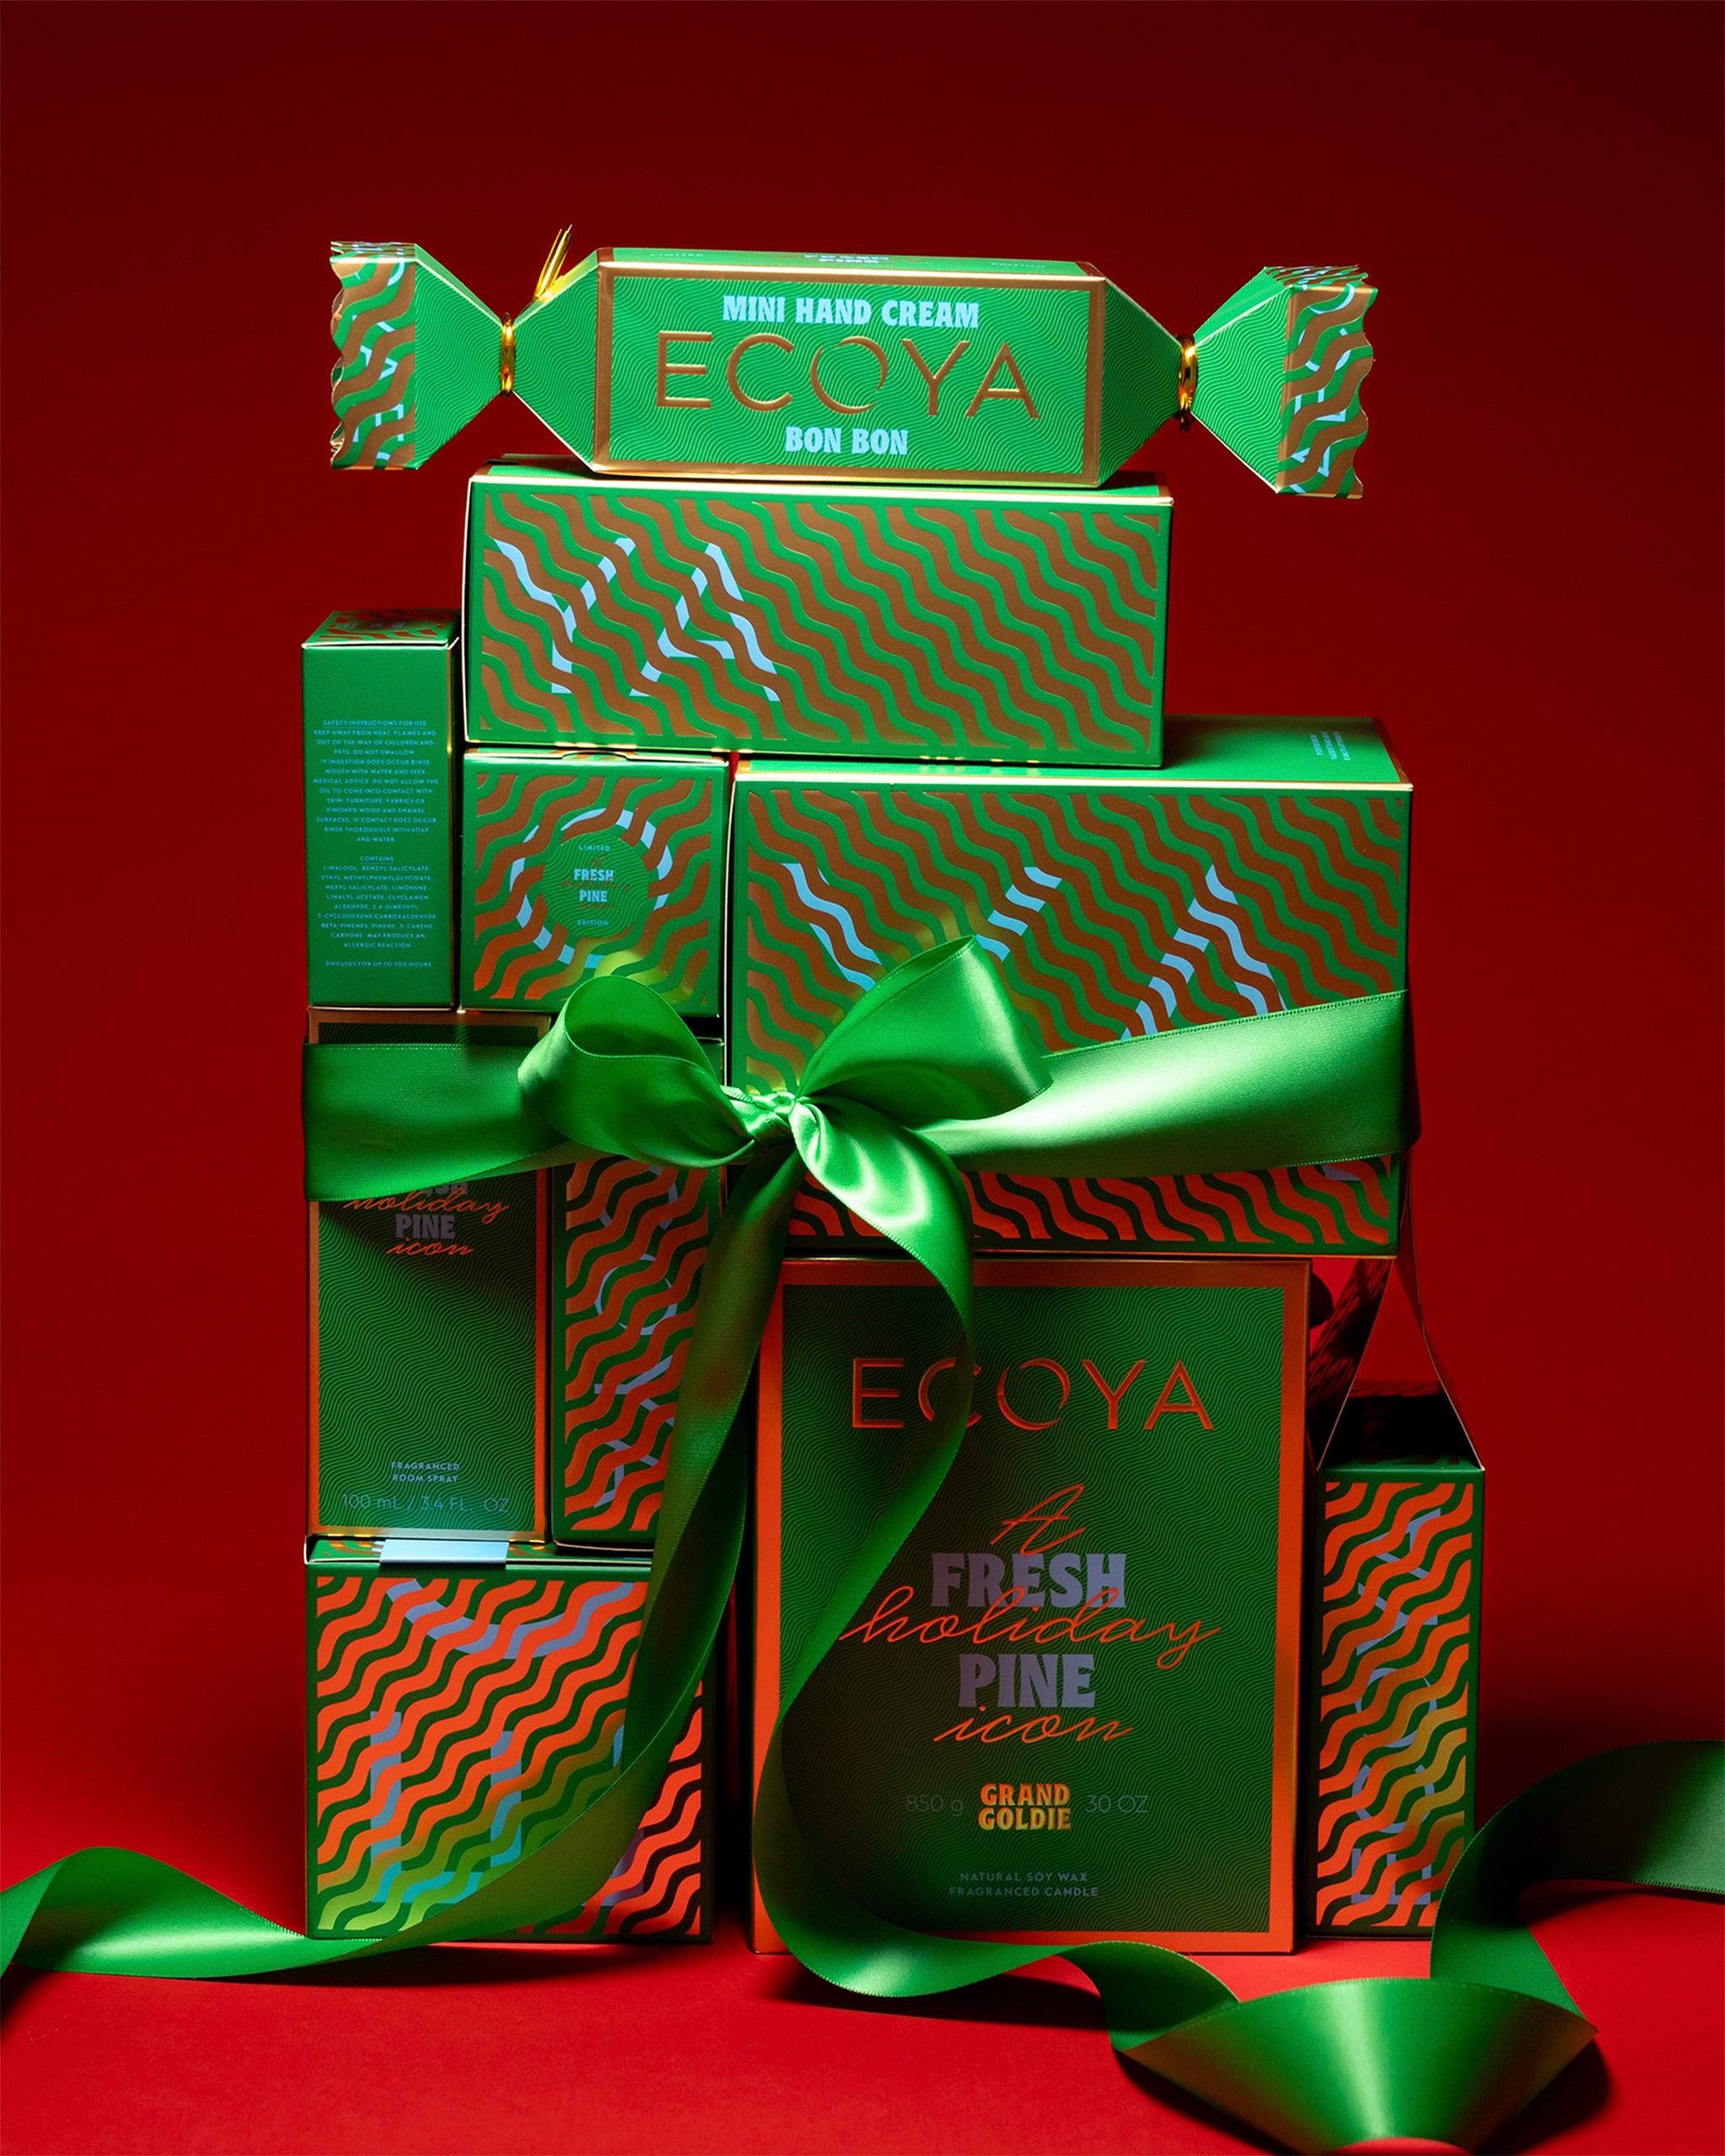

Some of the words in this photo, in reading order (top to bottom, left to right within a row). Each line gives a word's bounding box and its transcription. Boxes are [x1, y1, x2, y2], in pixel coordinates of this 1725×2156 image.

[722, 295, 786, 323] MINI
[795, 297, 871, 326] HAND
[881, 301, 980, 328] CREAM
[655, 331, 1039, 419] ECOYA
[784, 426, 841, 453] BON
[852, 429, 908, 456] BON
[574, 868, 614, 881] FRESH
[579, 889, 607, 902] PINE
[396, 1214, 456, 1240] PINE
[386, 1238, 474, 1257] icon
[852, 1357, 1214, 1431] ECOYA
[391, 1461, 460, 1470] FRAGRANCED
[393, 1474, 424, 1482] ROOM
[342, 1494, 371, 1509] 100
[420, 1497, 444, 1511] 3.4
[483, 1497, 510, 1513] OZ
[989, 1483, 1086, 1556] A
[931, 1551, 1127, 1609] FRESH
[839, 1585, 1221, 1671] holiday
[958, 1653, 1096, 1708] PINE
[932, 1705, 1134, 1743] icon
[905, 1795, 943, 1812] 850
[950, 1798, 964, 1817] g
[980, 1783, 1071, 1806] GRAND
[1085, 1795, 1112, 1813] 30
[1118, 1795, 1149, 1813] OZ
[978, 1807, 1072, 1831] GOLDIE
[960, 1871, 1021, 1882] NATURAL
[1027, 1872, 1052, 1882] SOY
[1058, 1872, 1087, 1882] WAX
[948, 1886, 1039, 1897] FRAGRANCED
[1044, 1886, 1098, 1897] CANDLE
